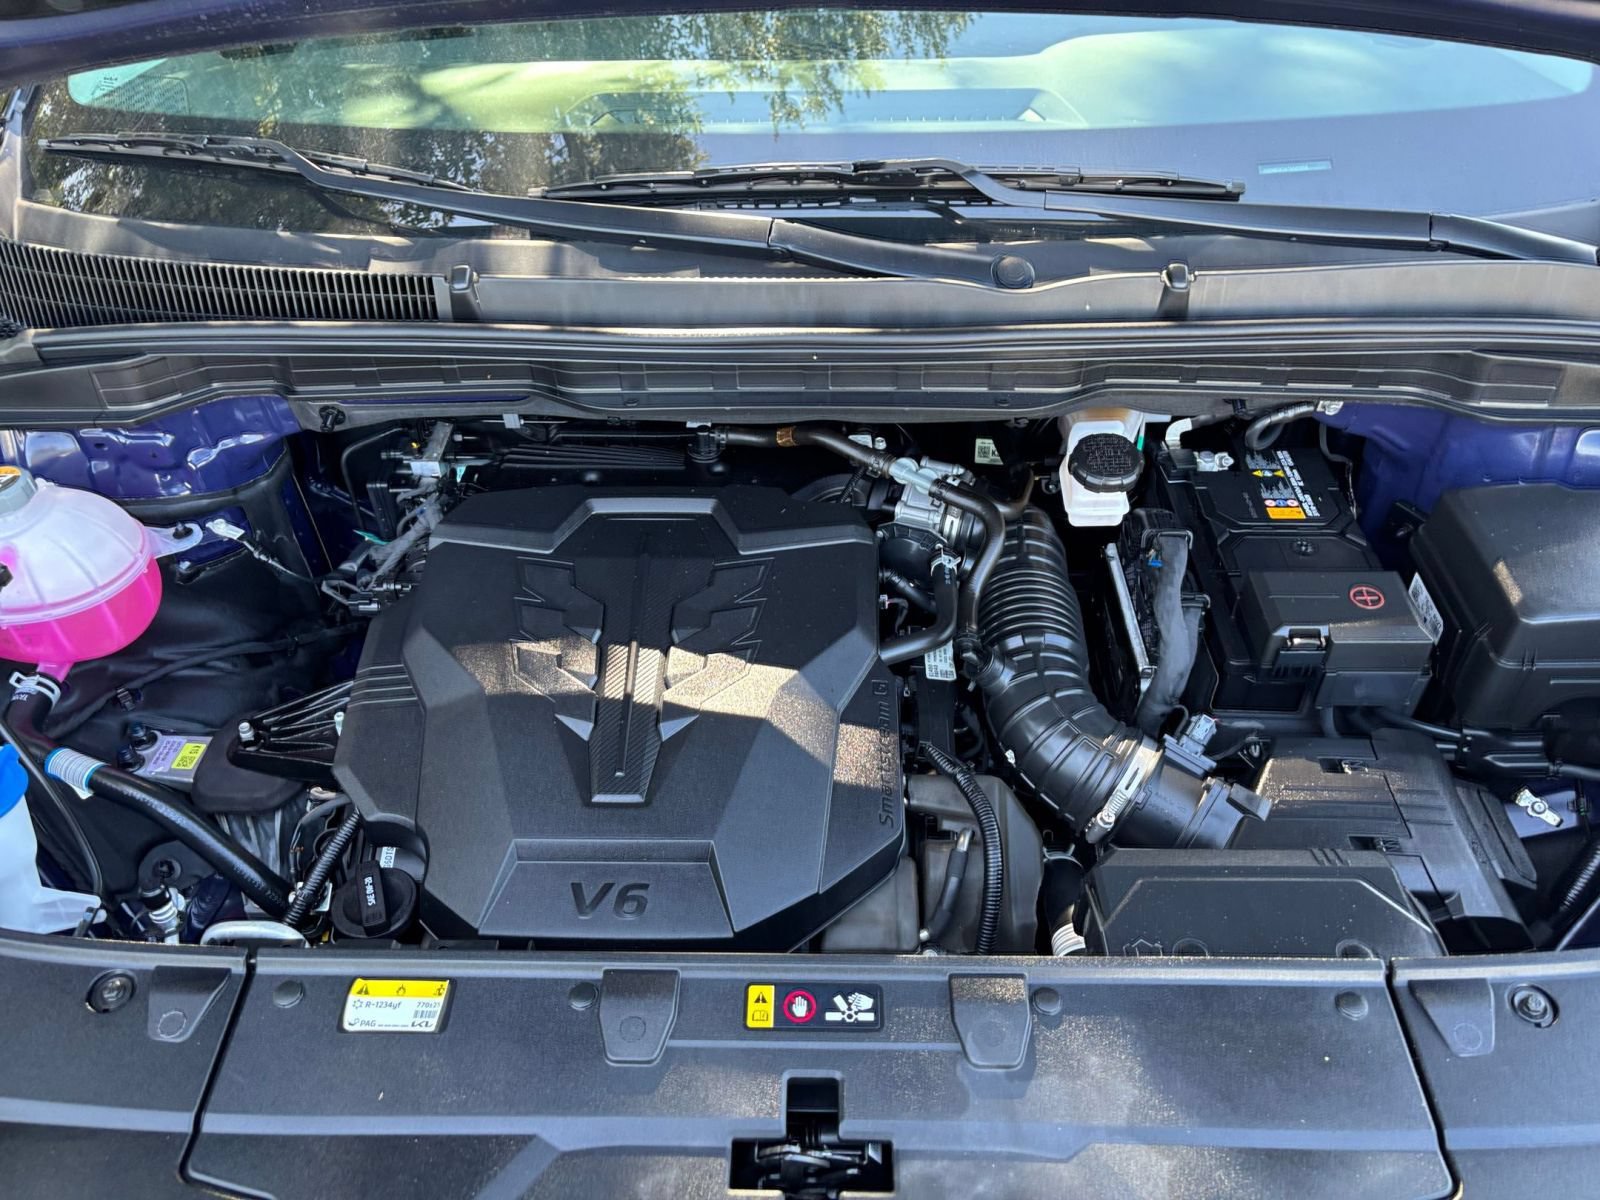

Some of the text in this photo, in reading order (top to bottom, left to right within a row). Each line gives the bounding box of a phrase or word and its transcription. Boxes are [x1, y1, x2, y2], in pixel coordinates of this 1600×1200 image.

[878, 700, 894, 829] Smartstream
[366, 893, 376, 906] SAE
[570, 882, 651, 920] V6
[365, 1001, 402, 1009] R-1234yf
